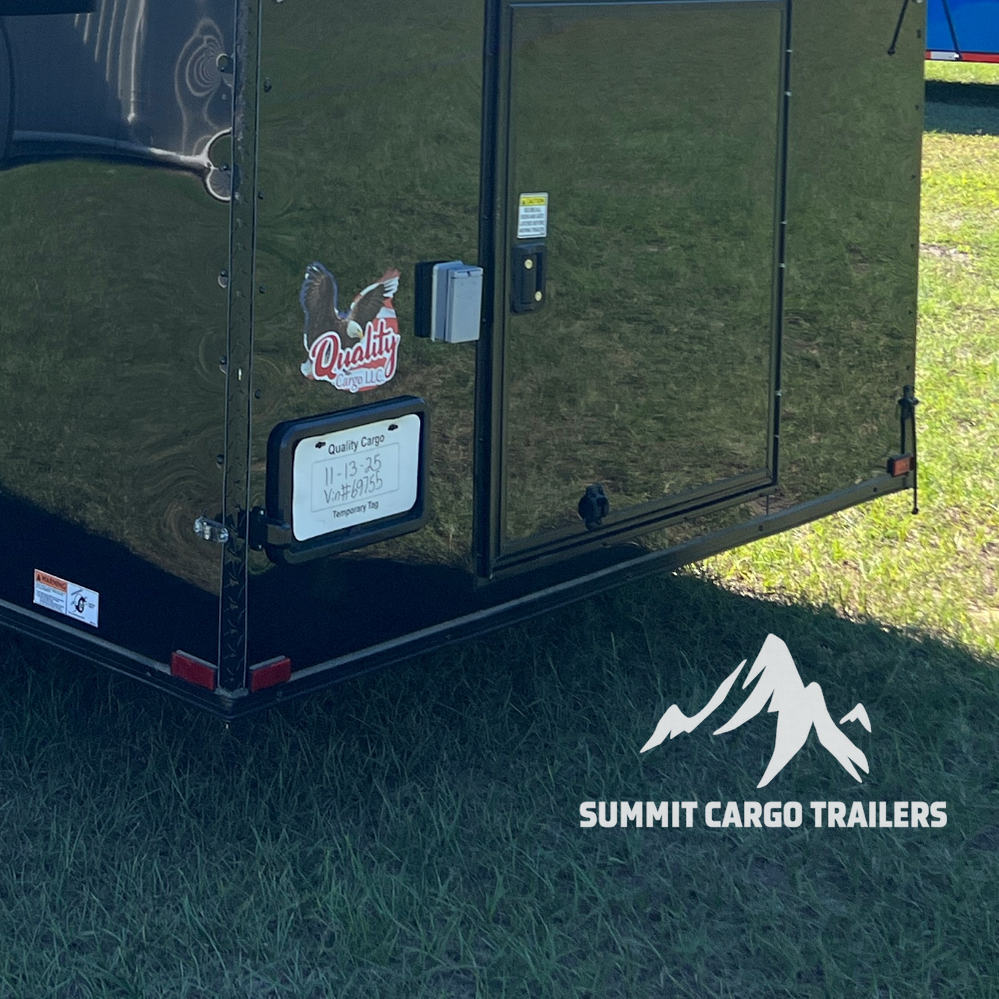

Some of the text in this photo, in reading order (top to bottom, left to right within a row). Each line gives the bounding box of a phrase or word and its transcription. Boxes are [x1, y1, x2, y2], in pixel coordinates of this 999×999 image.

[310, 319, 397, 381] Quality
[336, 373, 363, 390] Cargo
[328, 434, 385, 455] Quality Cargo
[332, 501, 379, 518] Temporary Tag
